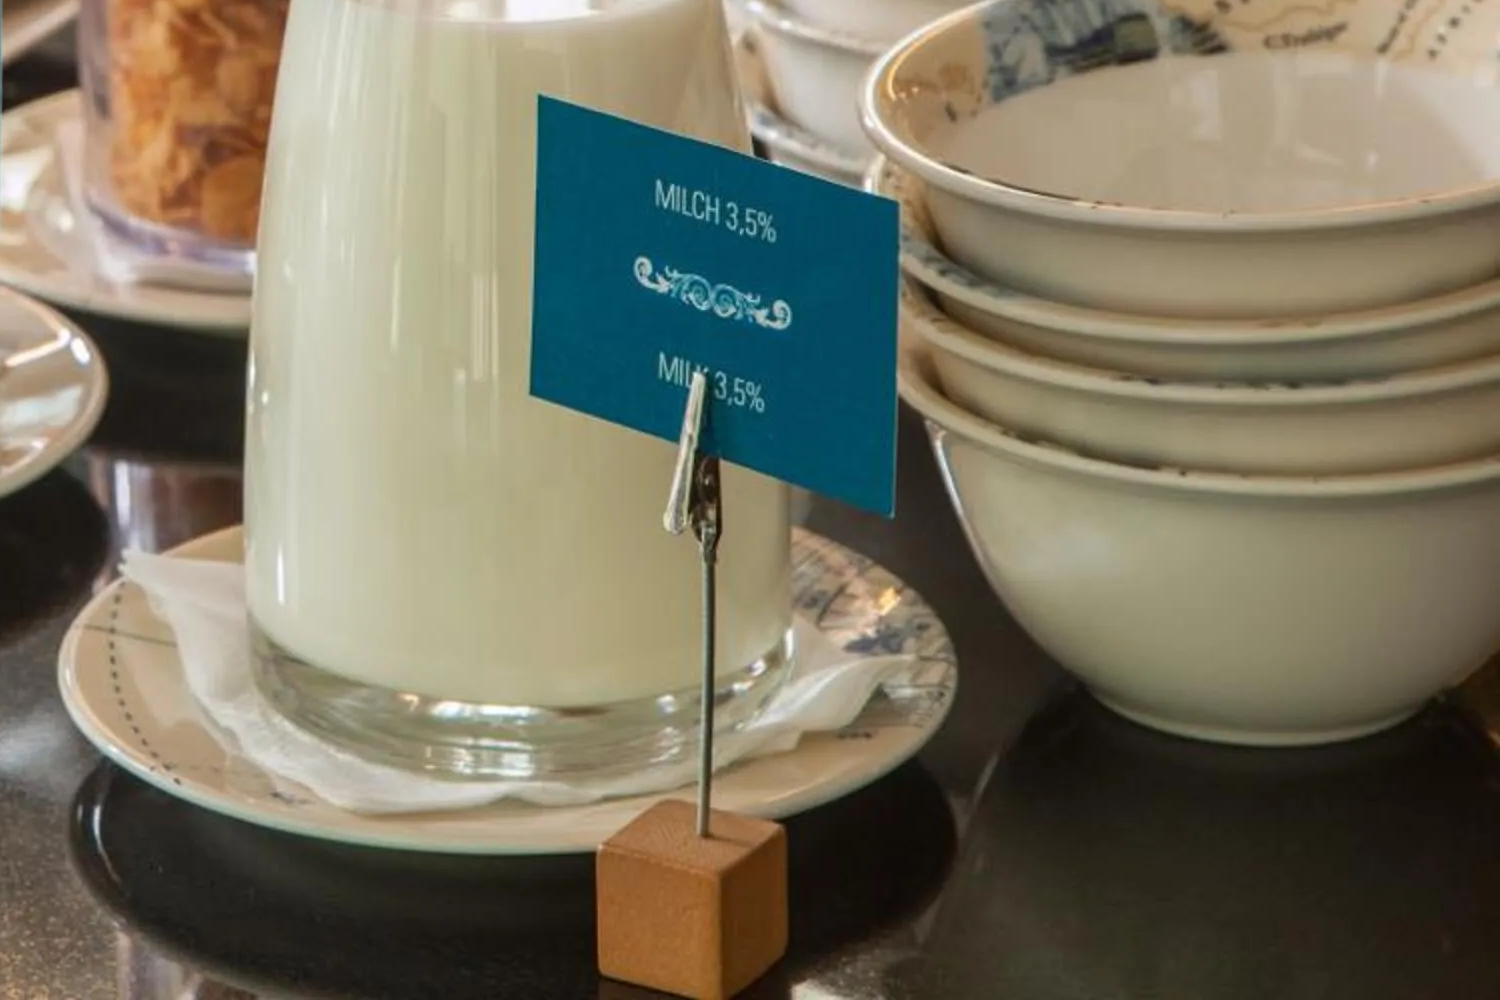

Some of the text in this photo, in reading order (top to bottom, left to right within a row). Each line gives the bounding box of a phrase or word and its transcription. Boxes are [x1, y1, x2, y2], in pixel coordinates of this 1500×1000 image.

[655, 178, 777, 243] MILCH 3,5%
[714, 369, 765, 413] 3,5%
